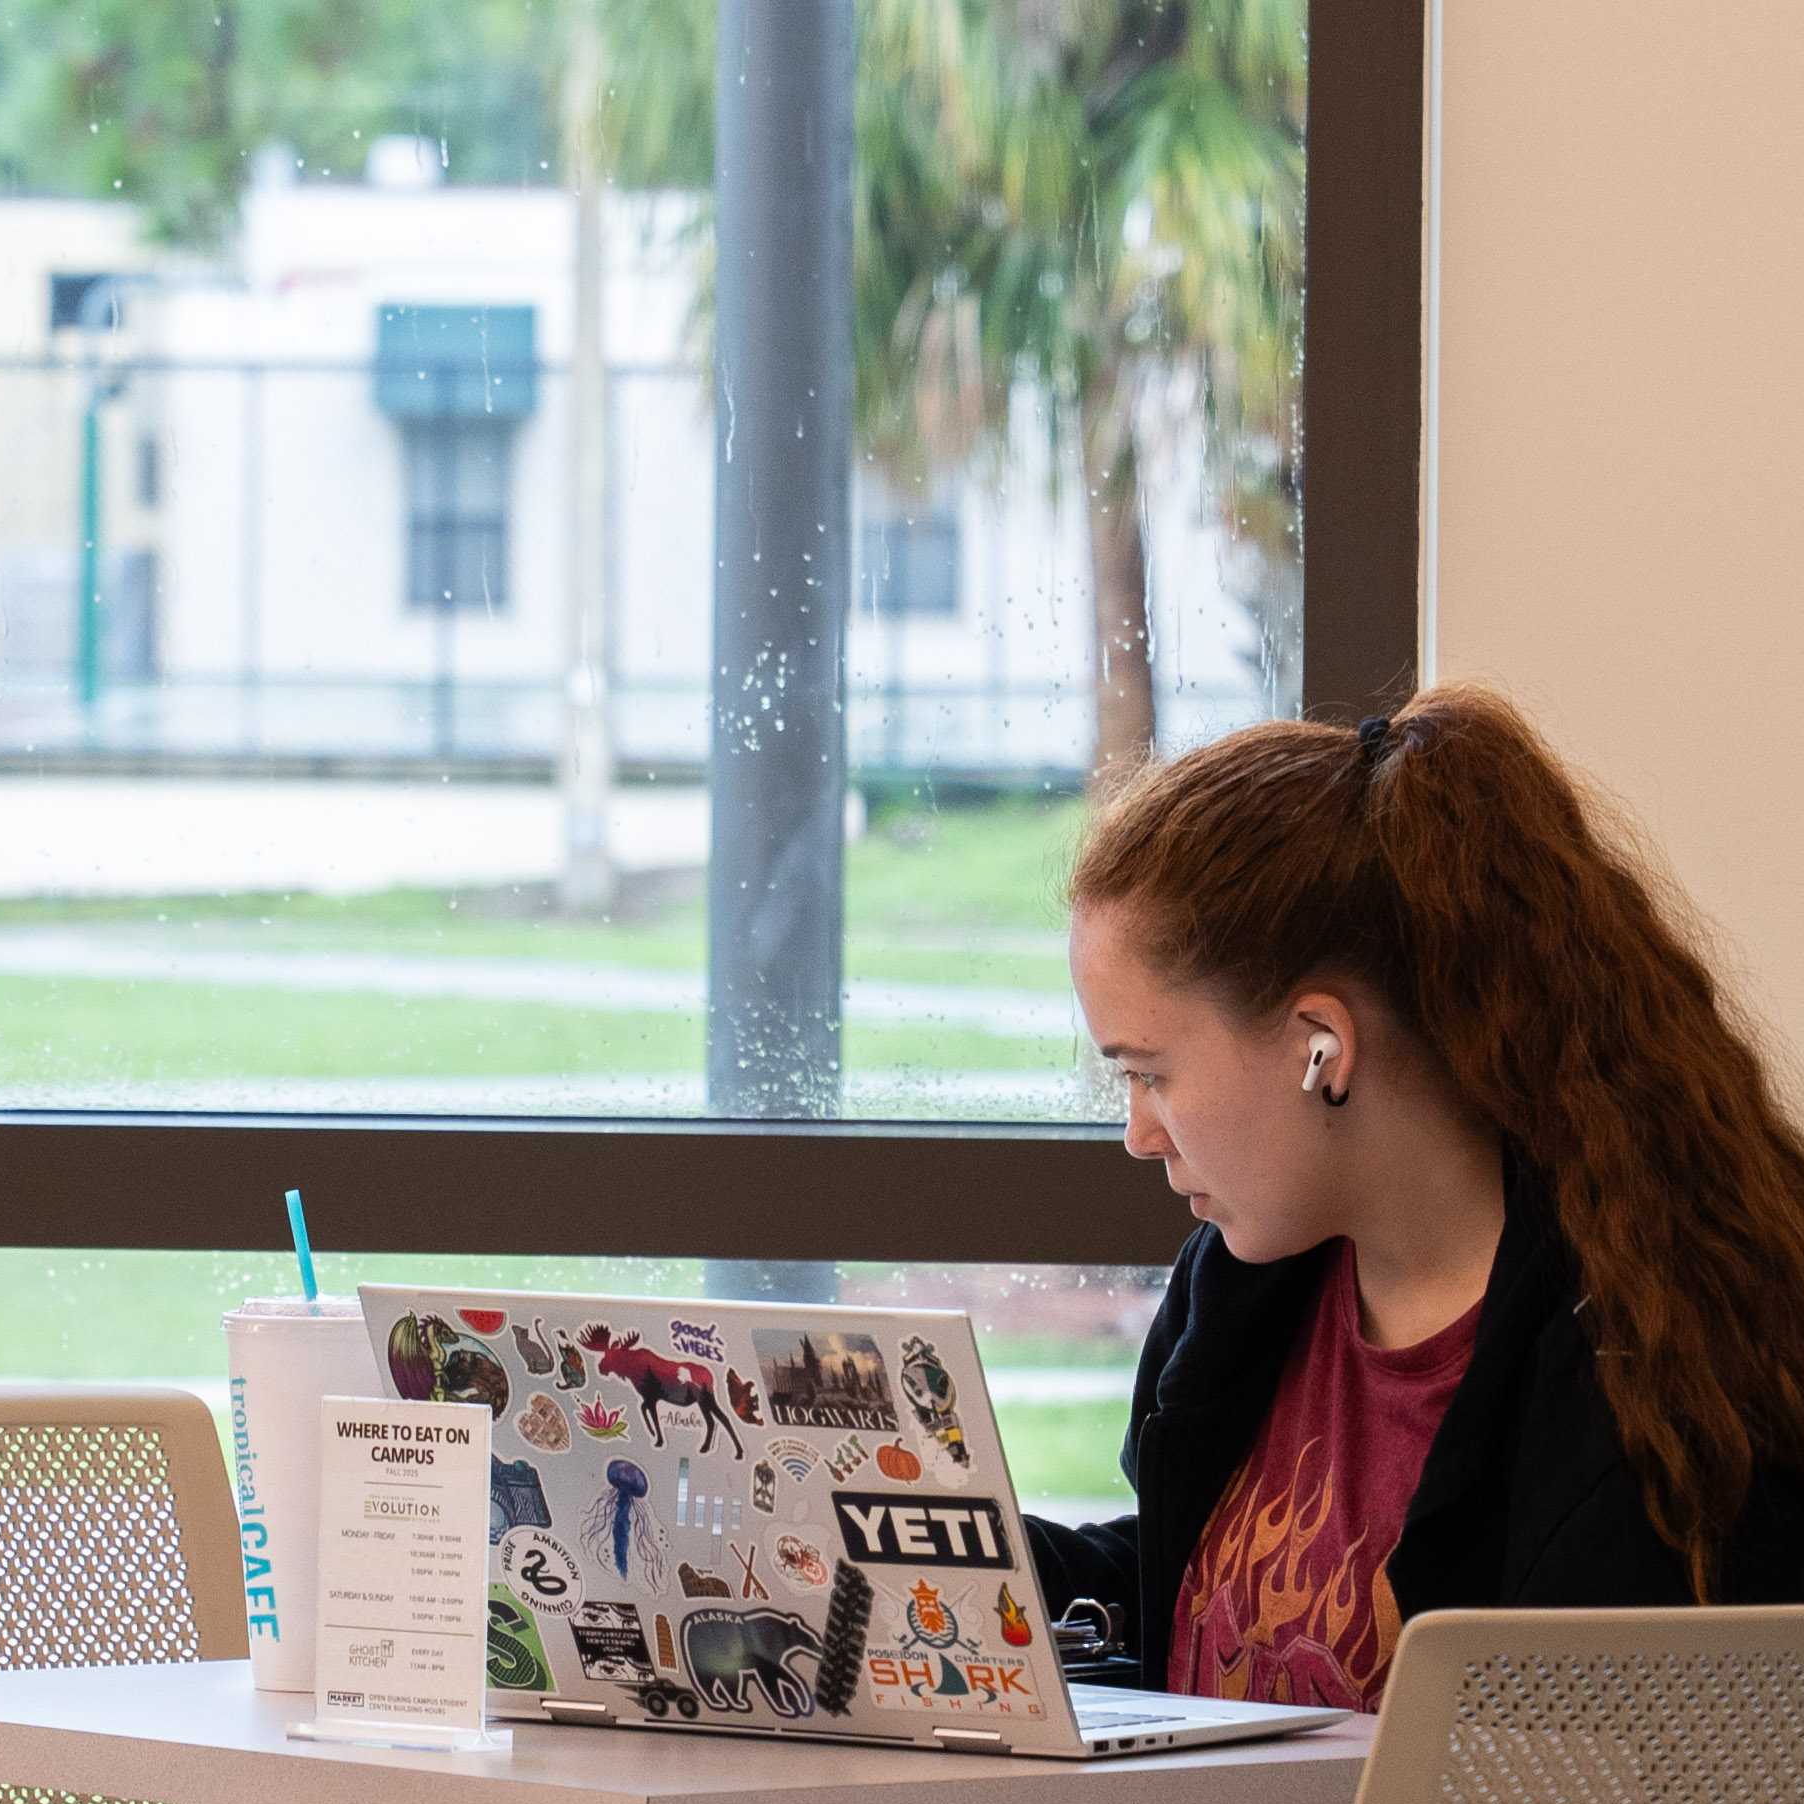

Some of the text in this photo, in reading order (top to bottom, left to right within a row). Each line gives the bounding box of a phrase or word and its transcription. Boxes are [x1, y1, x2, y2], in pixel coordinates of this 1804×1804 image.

[671, 1320, 716, 1342] good
[680, 1337, 724, 1362] VIBES
[662, 1410, 703, 1428] Alaska
[775, 1403, 898, 1431] HOGWARTS
[337, 1421, 470, 1444] WHERE TO EAT ON
[230, 1376, 265, 1516] tropical
[371, 1446, 435, 1465] CAMPUS
[385, 1467, 401, 1477] FALL
[364, 1500, 441, 1517] EVOLUTION
[341, 1529, 370, 1540] MONDAY
[373, 1531, 396, 1541] FRIDAY
[840, 1503, 1000, 1559] YETI
[504, 1540, 517, 1572] PRIDE
[533, 1532, 580, 1581] AMBITION
[329, 1590, 362, 1601] SATURDAY
[368, 1593, 395, 1602] SUNDAY
[426, 1596, 437, 1605] AM
[521, 1591, 573, 1615] CUNNING
[692, 1612, 744, 1625] ALASKA
[348, 1644, 380, 1656] GHOST
[411, 1648, 444, 1658] EVERY DAY
[867, 1648, 1025, 1667] POSEIDON CHARTERS
[348, 1656, 388, 1668] KITCHEN
[410, 1662, 427, 1671] 11AM
[330, 1693, 362, 1704] MARKET
[368, 1693, 468, 1708] OPEN DURING CAMPUS STUDENT
[875, 1693, 1041, 1715] FISHING
[368, 1702, 446, 1715] CENTER BUILDING HOURS
